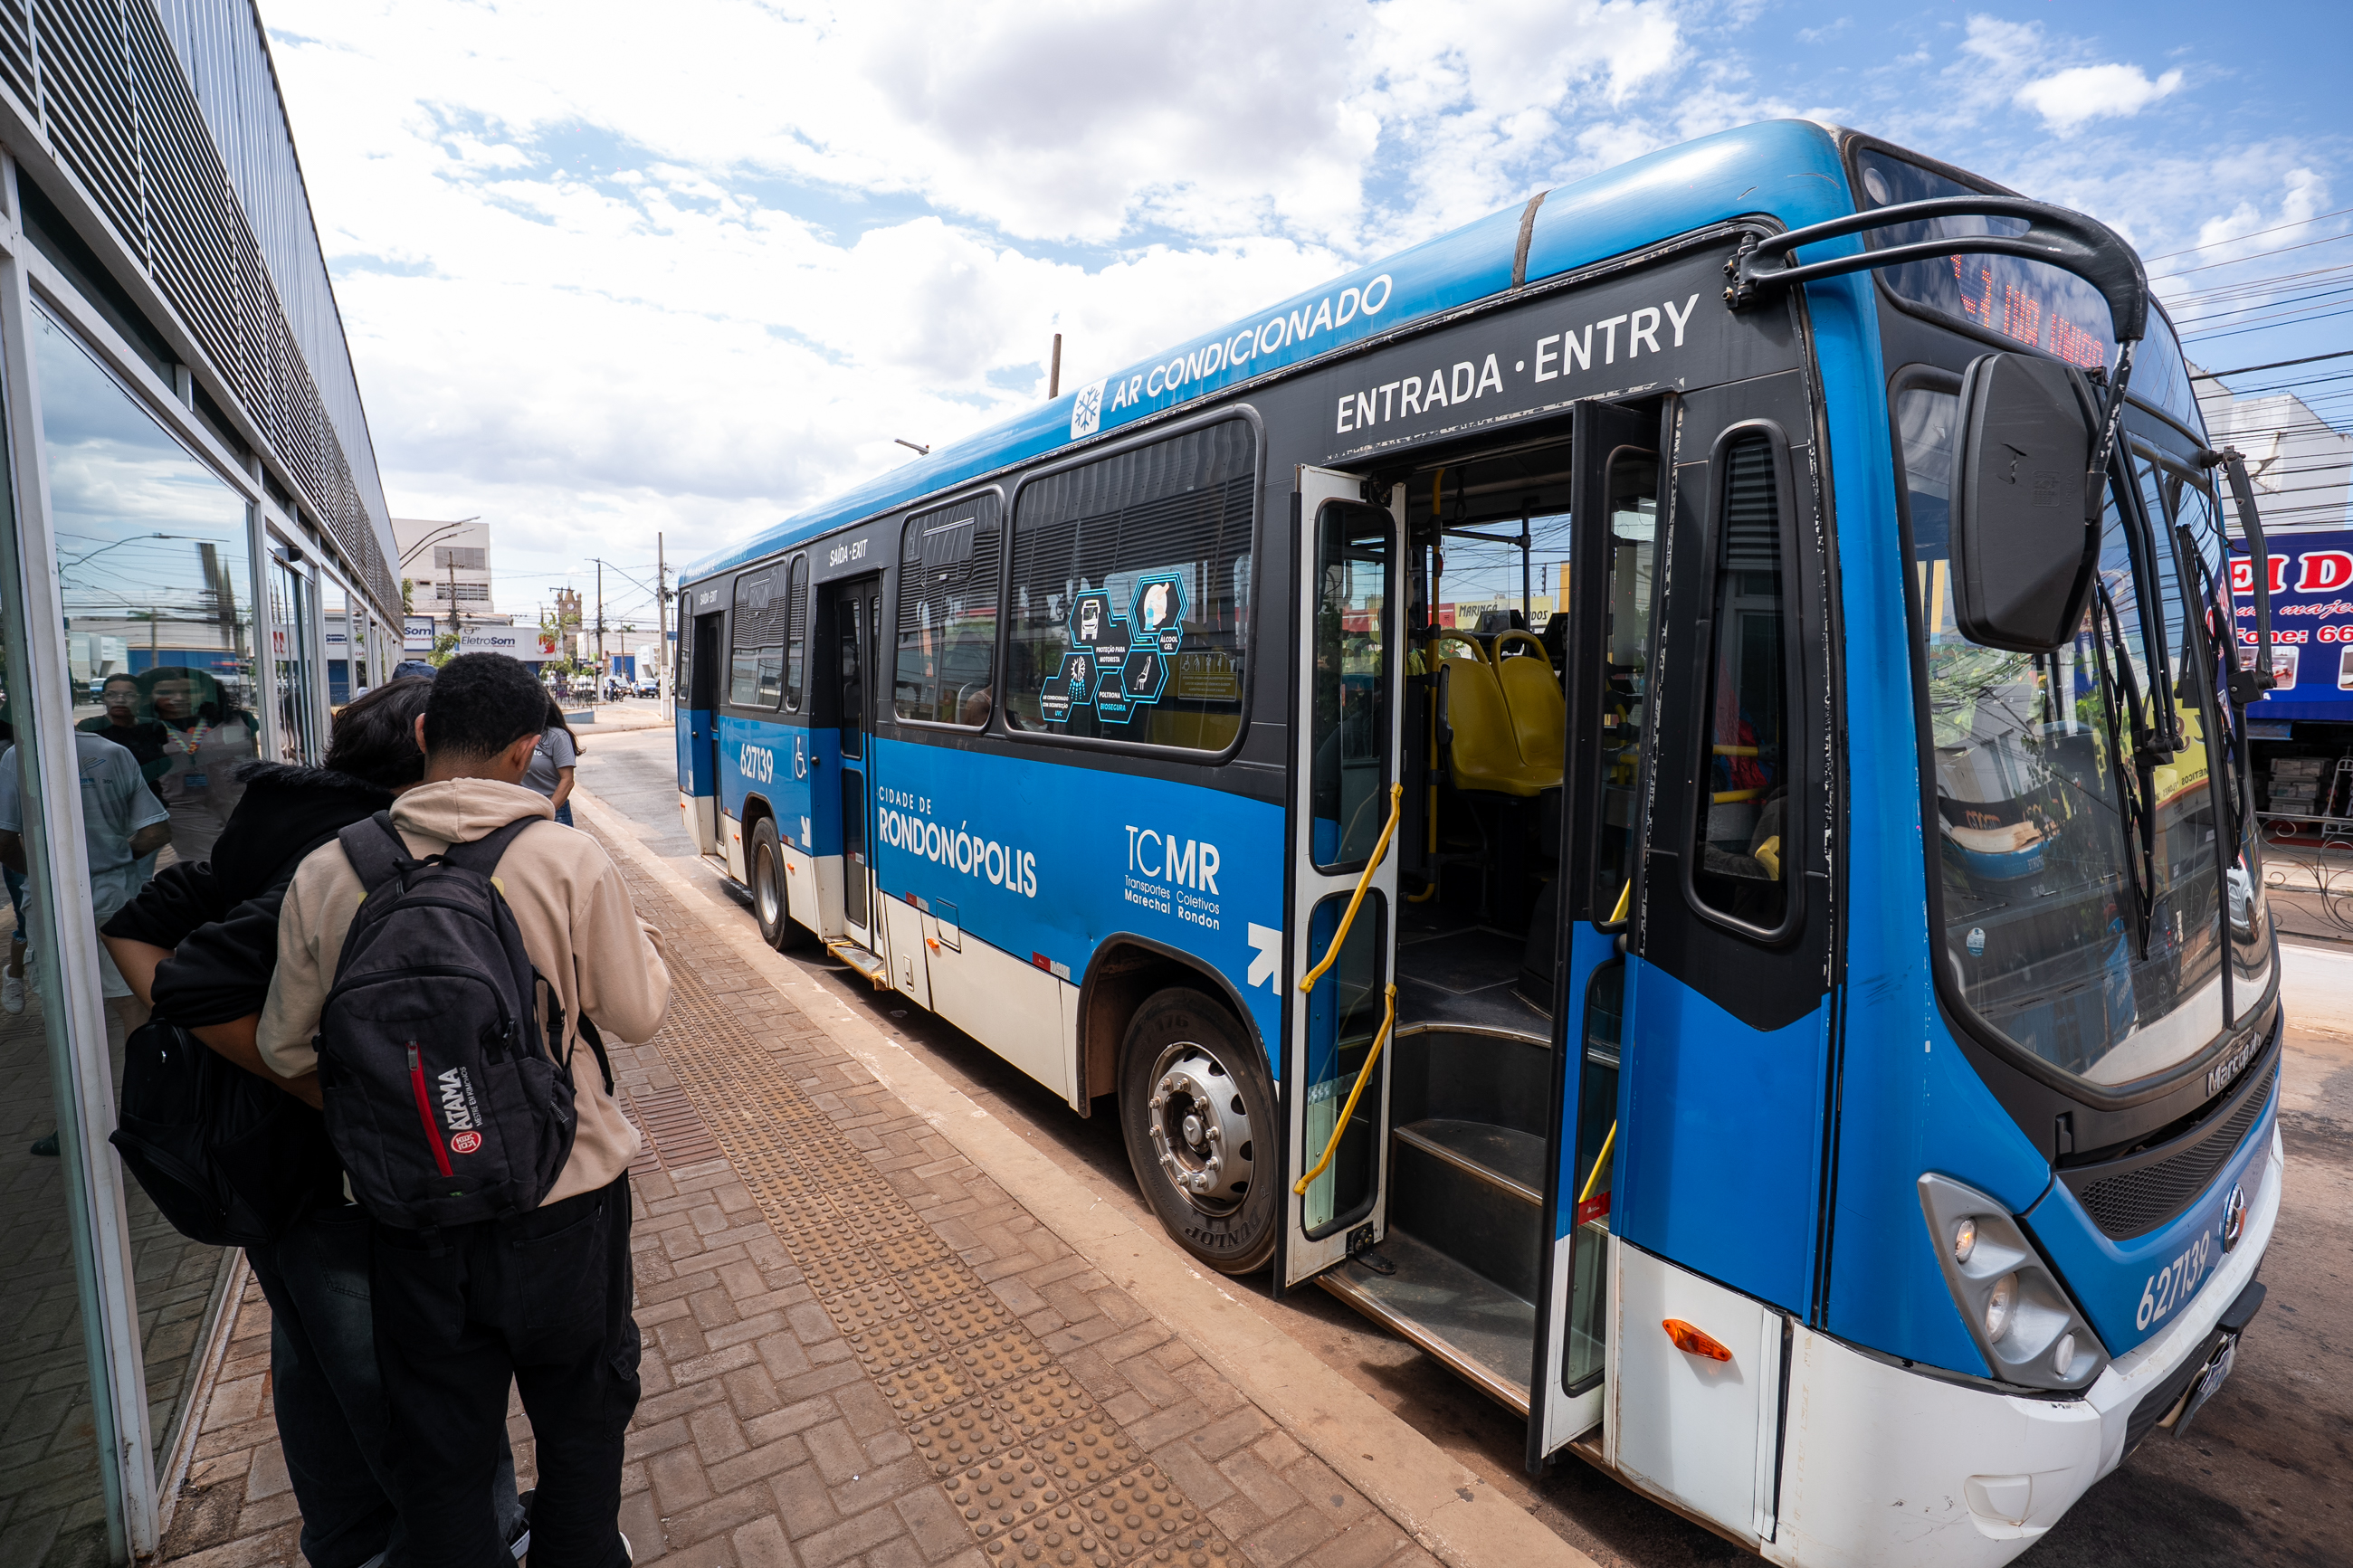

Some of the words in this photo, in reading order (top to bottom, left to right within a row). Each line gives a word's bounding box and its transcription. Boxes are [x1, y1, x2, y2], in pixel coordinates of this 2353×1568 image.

[1111, 375, 1139, 412] AR
[1146, 273, 1392, 396] CONDICIONADO
[1335, 352, 1503, 434] ENTRADA
[1535, 292, 1700, 383] ENTRY
[830, 543, 850, 567] SAÍDA
[852, 538, 868, 561] EXIT
[461, 635, 516, 645] EletroSom
[1159, 634, 1178, 643] ÁLCOOL
[1099, 690, 1121, 699] POLTRONA
[1100, 702, 1127, 712] BIOSEGURA
[740, 743, 774, 784] 627139
[879, 785, 914, 811] CIDADE
[919, 796, 932, 814] DE
[879, 806, 1038, 898] RONDONÓPOLIS
[1125, 825, 1221, 896] TCMR
[1124, 874, 1171, 900] Transportes
[1176, 890, 1220, 915] Coletivos
[1124, 889, 1171, 915] Marechal
[1177, 906, 1220, 931] Rondon
[437, 1067, 473, 1130] ATAMA
[471, 1106, 483, 1127] MESTRE
[1184, 1204, 1262, 1250] DUNLOP
[2136, 1230, 2211, 1332] 627139
